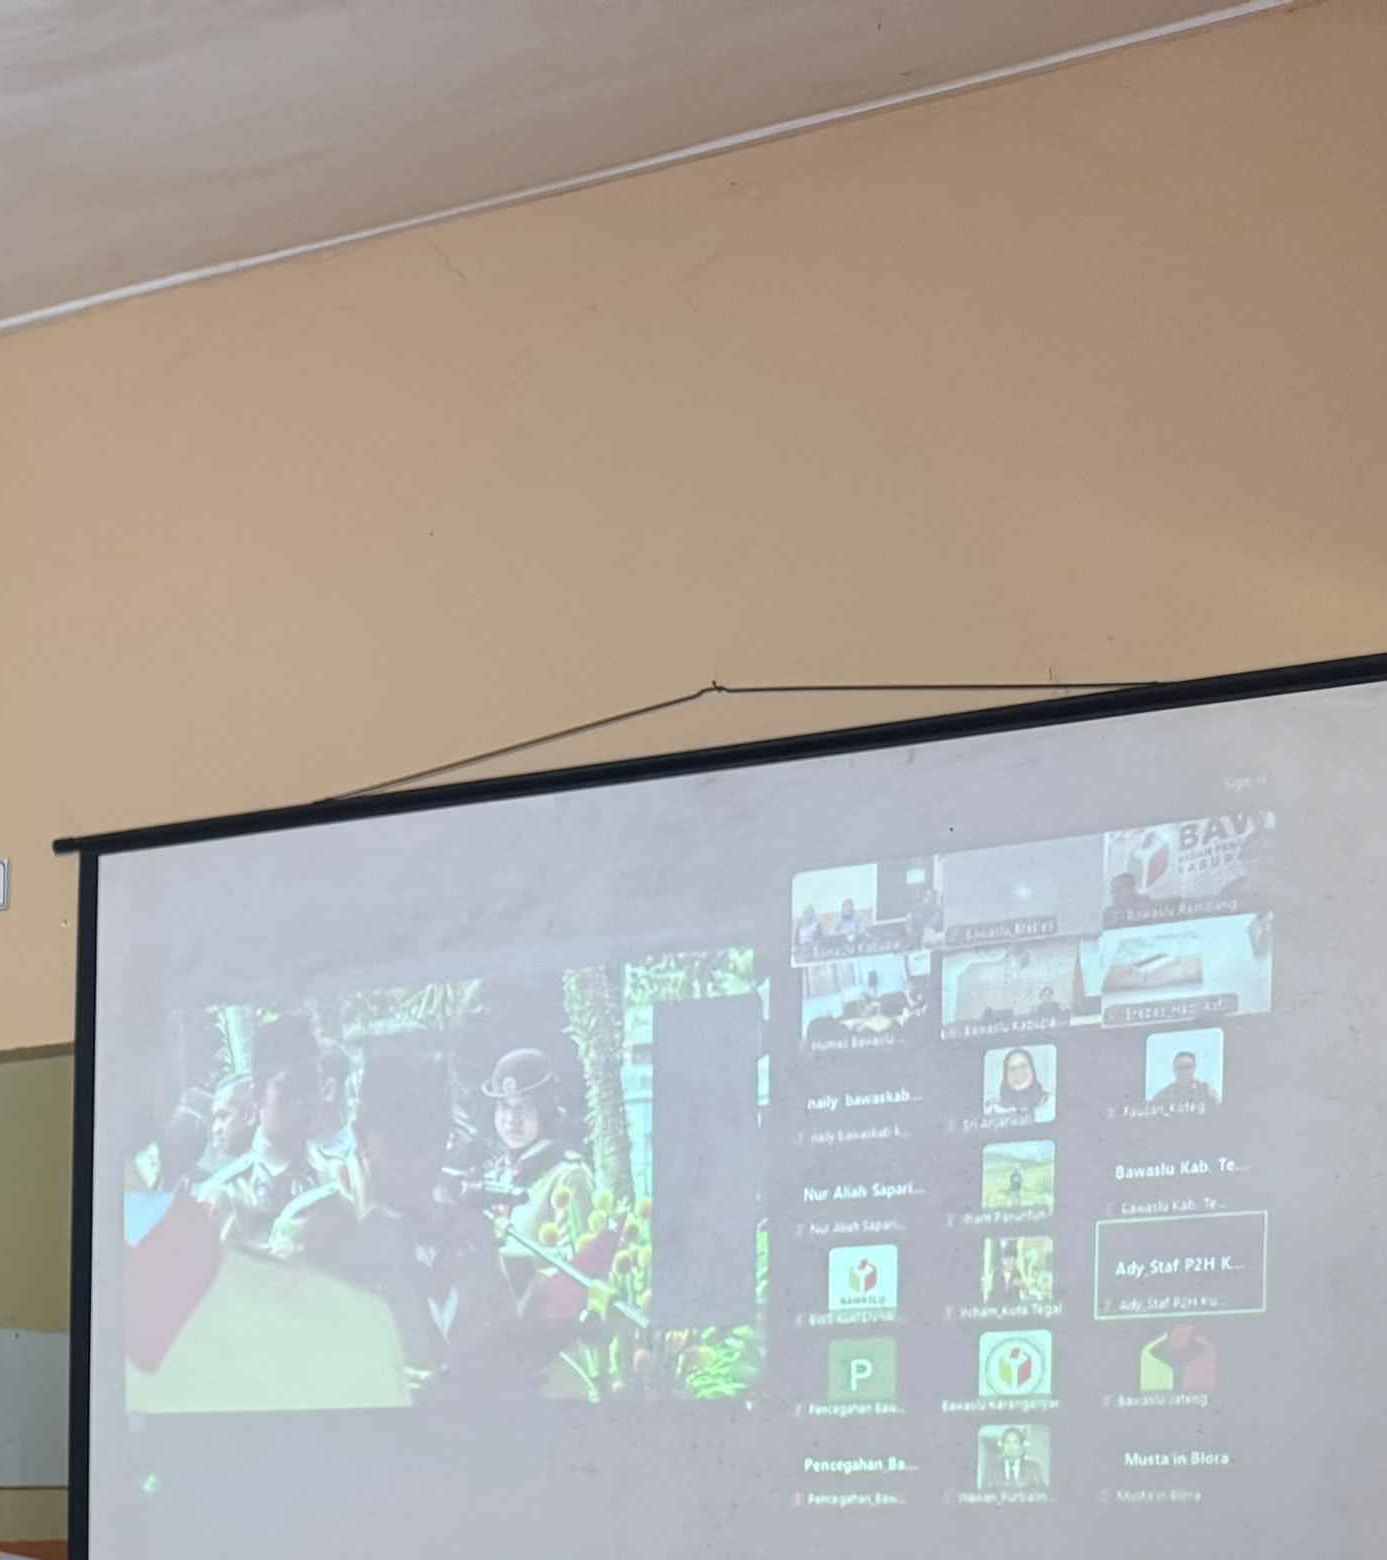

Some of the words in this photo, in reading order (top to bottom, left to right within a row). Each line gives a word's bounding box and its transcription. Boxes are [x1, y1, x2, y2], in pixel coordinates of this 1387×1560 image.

[1115, 1162, 1175, 1180] Bawaslu
[1184, 1256, 1216, 1272] P2H
[851, 1359, 873, 1391] P
[1190, 1450, 1230, 1465] Blora
